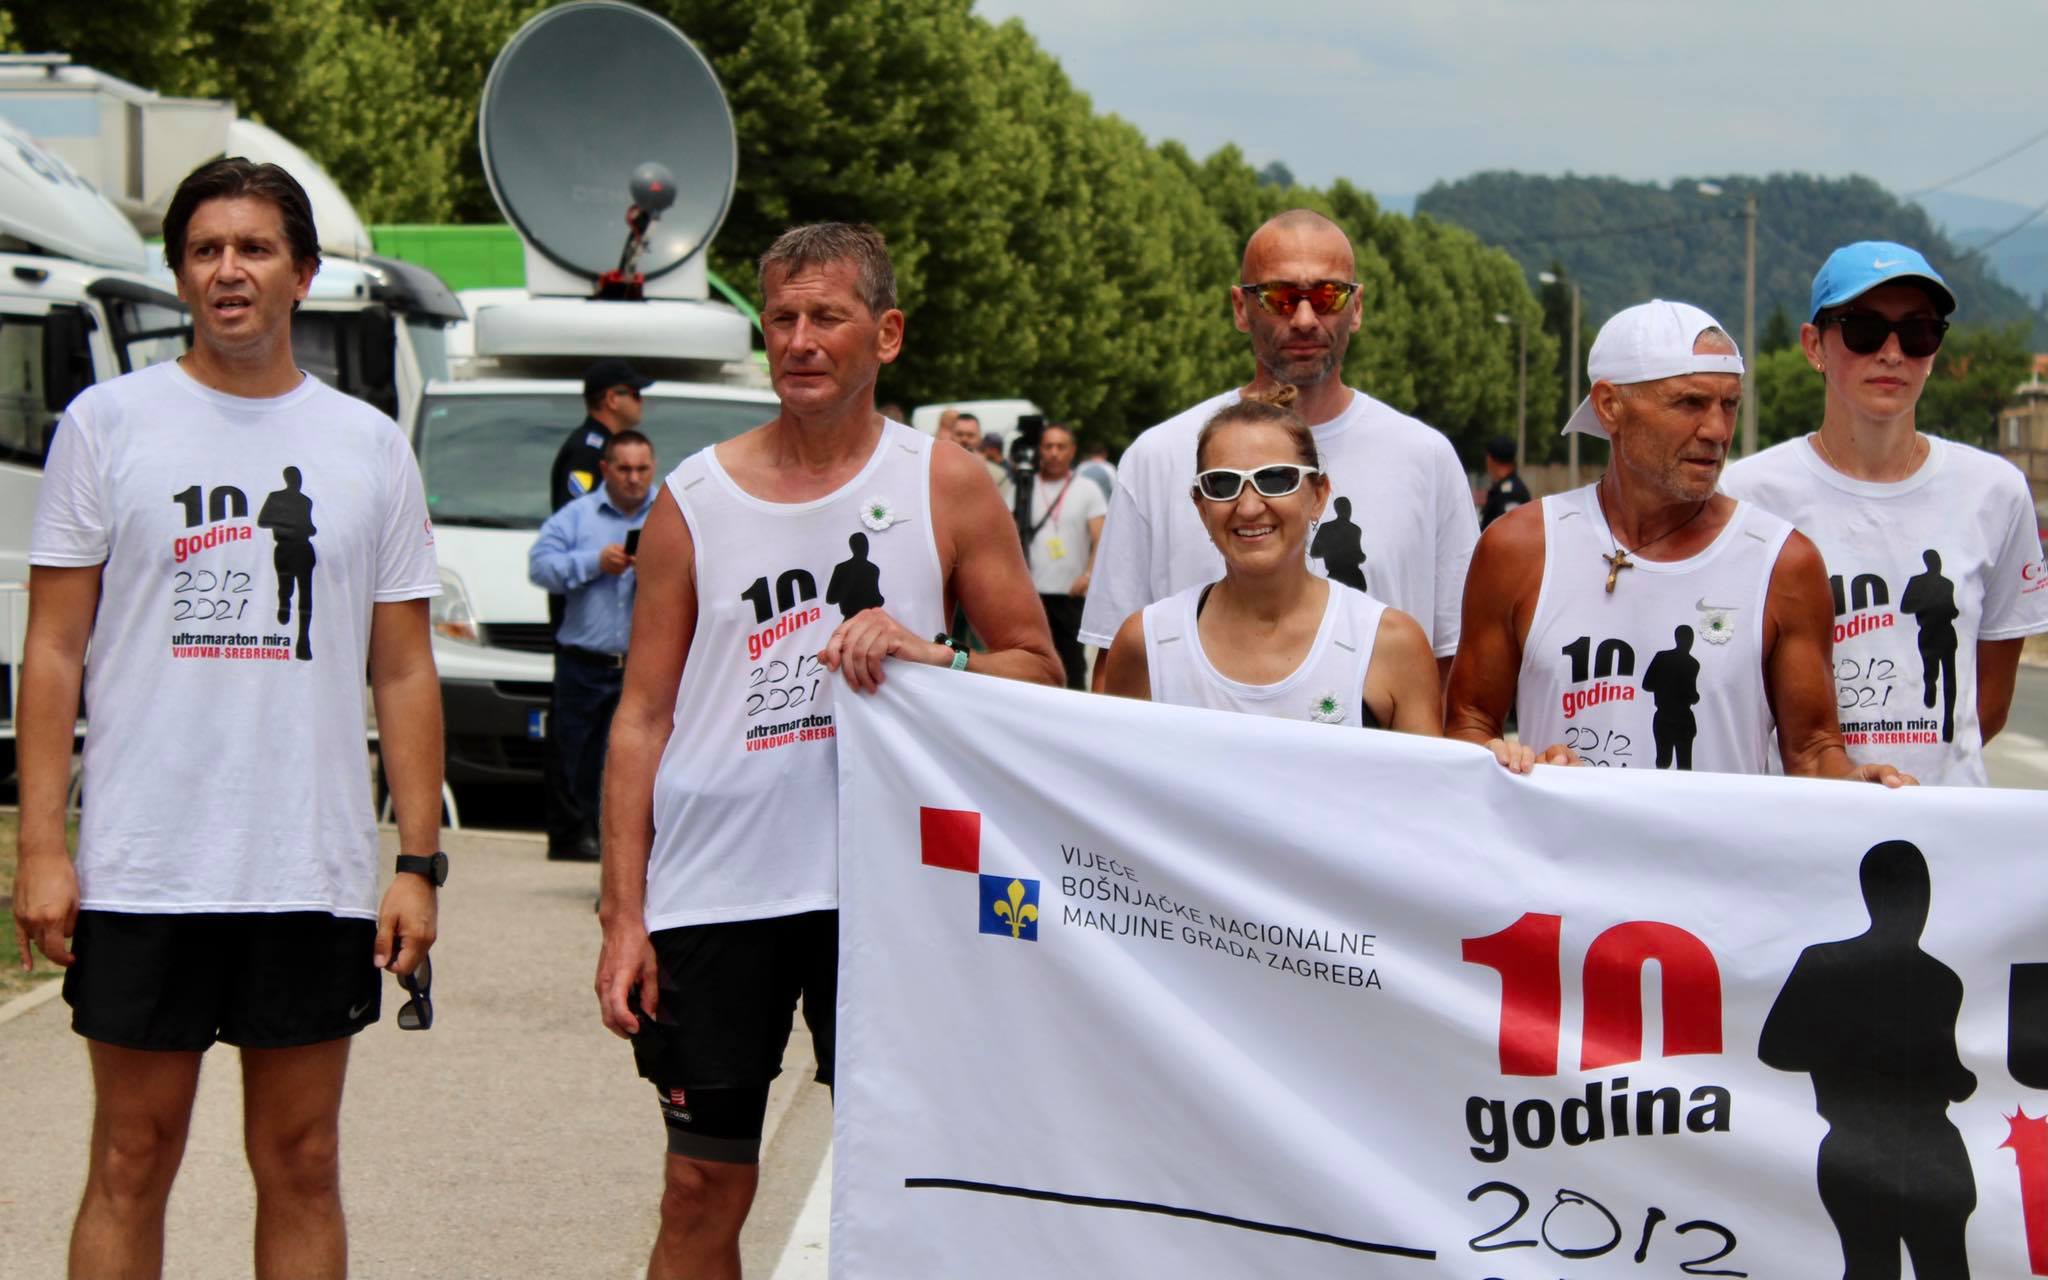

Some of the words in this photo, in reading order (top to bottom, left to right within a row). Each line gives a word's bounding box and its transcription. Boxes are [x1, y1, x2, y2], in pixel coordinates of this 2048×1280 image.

[173, 485, 248, 528] 10
[174, 525, 252, 563] godina
[174, 570, 253, 593] 2012
[741, 569, 817, 624] 10
[174, 599, 248, 621] 2021
[172, 633, 258, 646] ultramaraton
[262, 634, 290, 646] mira
[748, 607, 820, 661] godina
[1832, 612, 1893, 644] odina
[172, 646, 290, 660] VUKOVAR-SREBRENICA
[1562, 636, 1635, 683] 10
[1832, 658, 1896, 681] 012
[750, 655, 823, 688] 2012
[747, 680, 819, 716] 2021
[1563, 681, 1635, 719] godina
[1838, 685, 1892, 708] 021
[746, 726, 837, 752] VUKOVAR-SREBR
[747, 714, 832, 740] ultramaraton
[1565, 727, 1632, 756] 2012
[1839, 719, 1902, 733] amaraton
[1907, 718, 1937, 731] mira
[1062, 875, 1204, 925] BOŠNJAČKE
[1209, 914, 1377, 957] NACIONALNE
[1063, 905, 1174, 941] MANJINE
[1182, 926, 1261, 964] GRADA
[1266, 952, 1382, 990] ZAGREBA
[1461, 911, 1723, 1077] 10
[1465, 1076, 1731, 1163] godina
[1467, 1181, 1748, 1278] 2012
